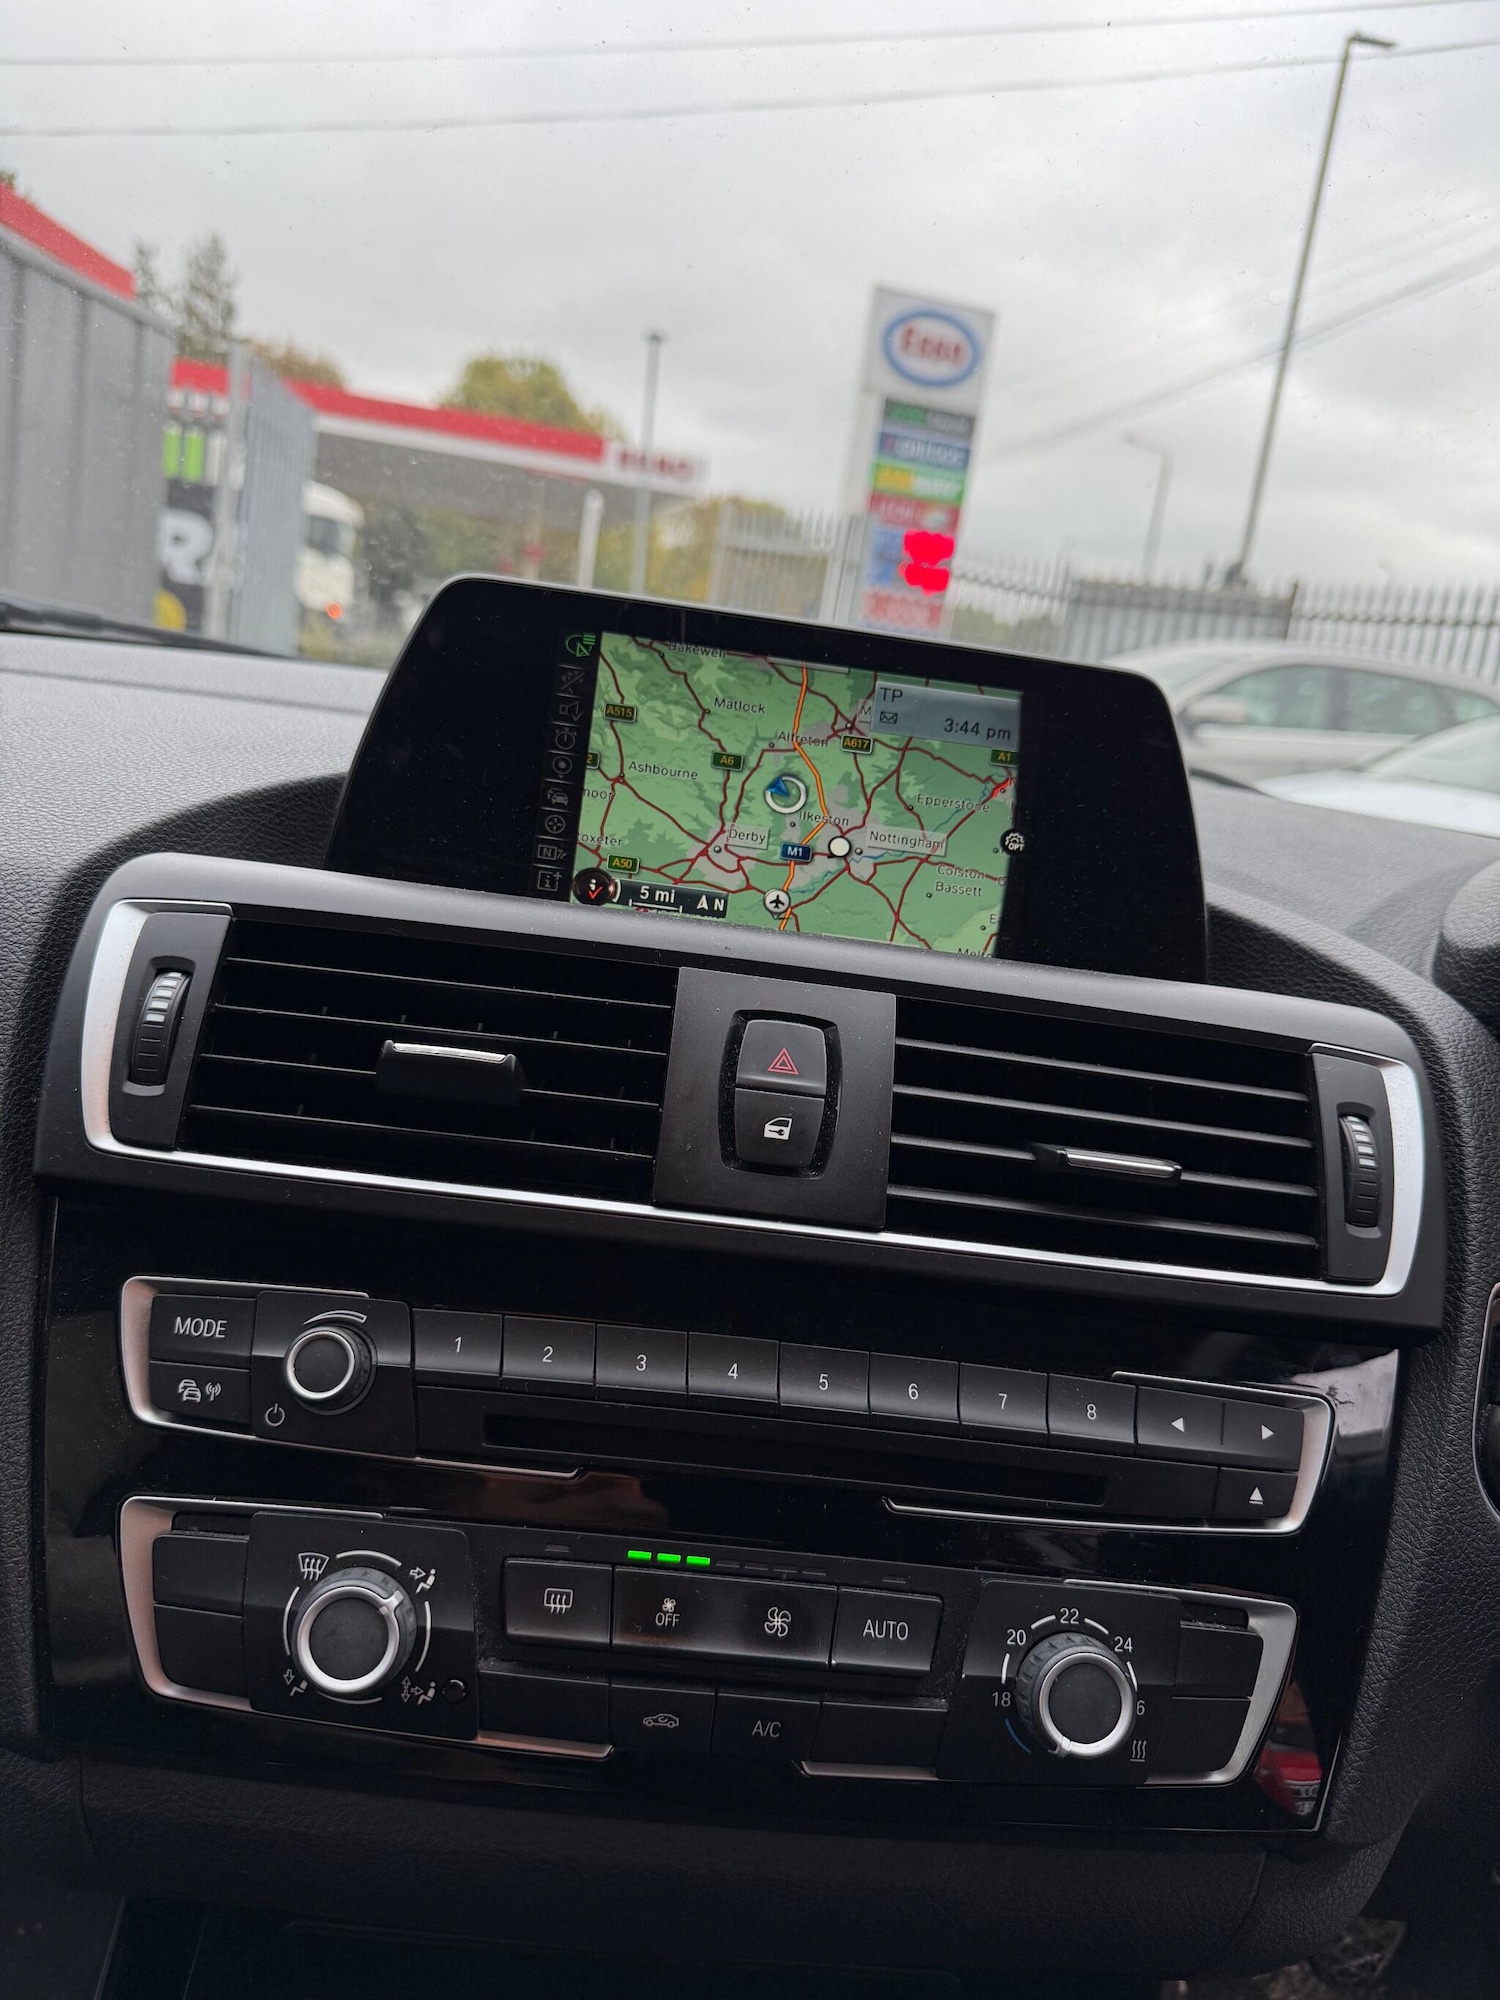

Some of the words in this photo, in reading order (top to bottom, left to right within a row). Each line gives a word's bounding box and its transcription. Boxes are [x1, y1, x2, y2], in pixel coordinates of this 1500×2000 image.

[669, 641, 727, 659] Bakewell
[880, 687, 903, 702] TP
[606, 704, 633, 718] A515
[714, 698, 765, 714] Matlock
[943, 718, 980, 736] 3:44
[986, 728, 1011, 741] pm
[778, 732, 829, 748] Alfreton
[843, 737, 870, 751] A617
[720, 754, 734, 766] A6
[998, 753, 1011, 762] A1
[628, 761, 698, 780] Ashbourne
[917, 794, 990, 814] Epperstone
[799, 811, 849, 826] Ilkeston
[728, 828, 766, 844] Derby
[869, 831, 944, 851] Nottingham
[787, 846, 803, 857] M1
[1008, 843, 1024, 851] OPT
[612, 858, 632, 869] A50
[937, 865, 985, 881] Colston
[640, 887, 650, 899] 5
[655, 889, 675, 903] mi
[935, 881, 982, 897] Bassett
[174, 1316, 228, 1338] MODE
[454, 1337, 463, 1353] 1
[542, 1346, 554, 1363] 2
[635, 1354, 647, 1372] 3
[727, 1362, 739, 1380] 4
[818, 1374, 829, 1391] 5
[908, 1383, 919, 1401] 6
[998, 1393, 1009, 1410] 7
[1086, 1402, 1097, 1421] 8
[655, 1612, 680, 1628] OFF
[1059, 1607, 1080, 1625] 22
[863, 1619, 909, 1640] AUTO
[1006, 1629, 1027, 1646] 20
[1114, 1636, 1133, 1653] 24
[992, 1691, 1011, 1707] 18
[752, 1719, 781, 1738] A/C
